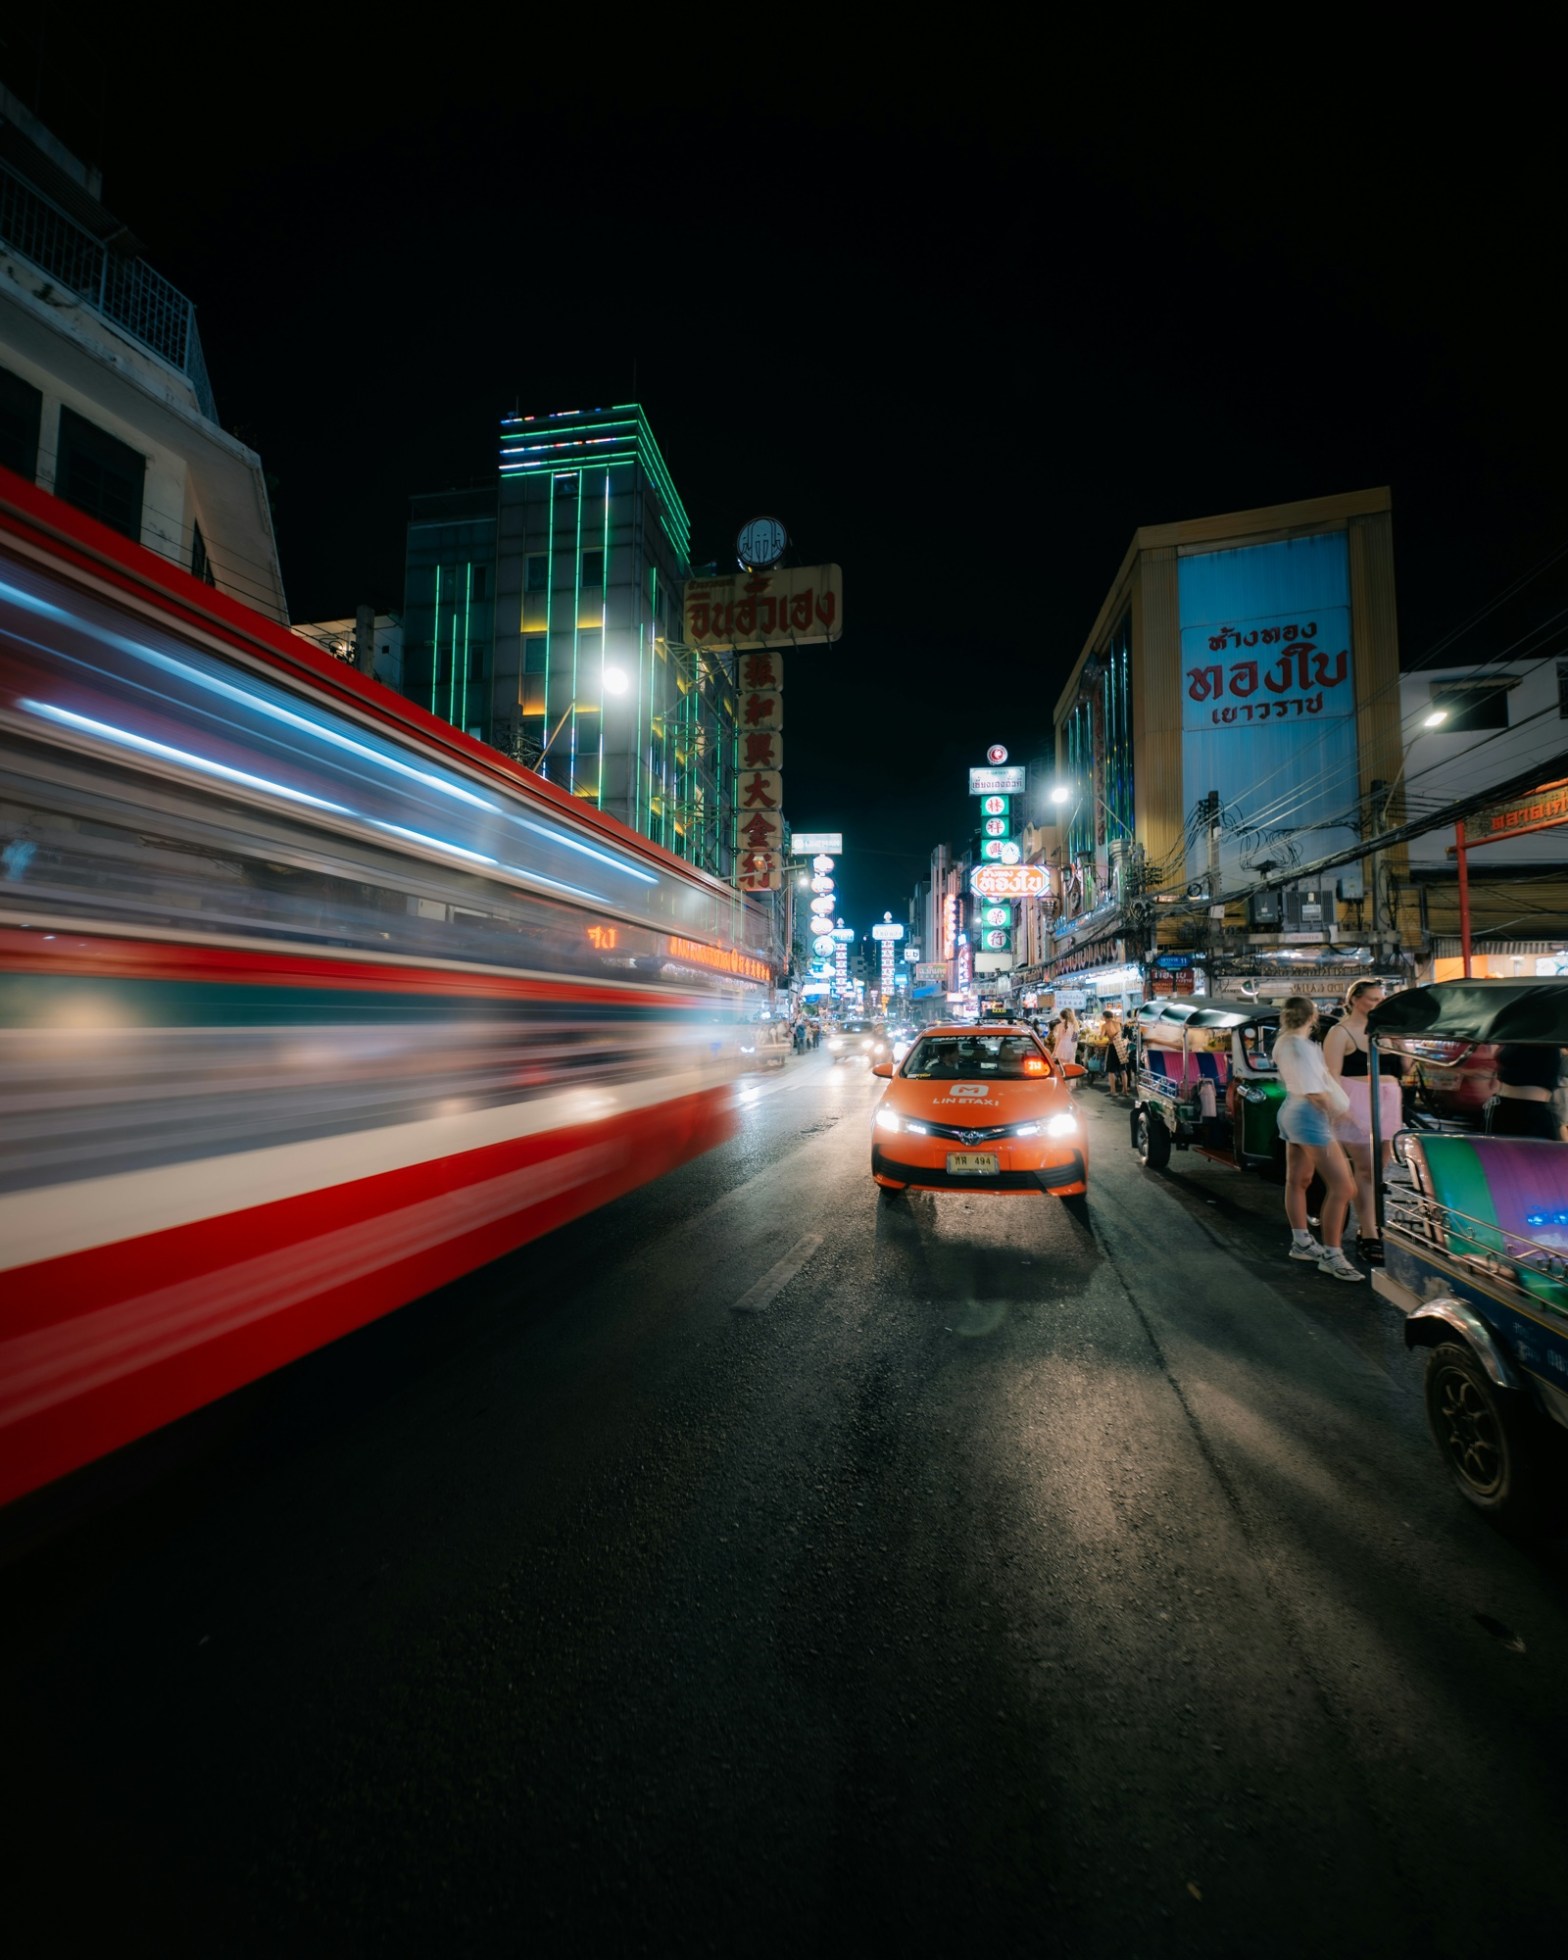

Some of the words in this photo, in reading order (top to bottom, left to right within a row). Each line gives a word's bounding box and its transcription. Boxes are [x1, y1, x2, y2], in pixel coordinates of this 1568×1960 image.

[1208, 622, 1317, 651] ห้างทอง
[1187, 642, 1349, 702] ทองใบ
[1211, 692, 1323, 724] เยาวราช
[1491, 789, 1568, 830] ตลาดเก่
[979, 870, 1041, 892] ทองใบ
[975, 1156, 991, 1165] 494
